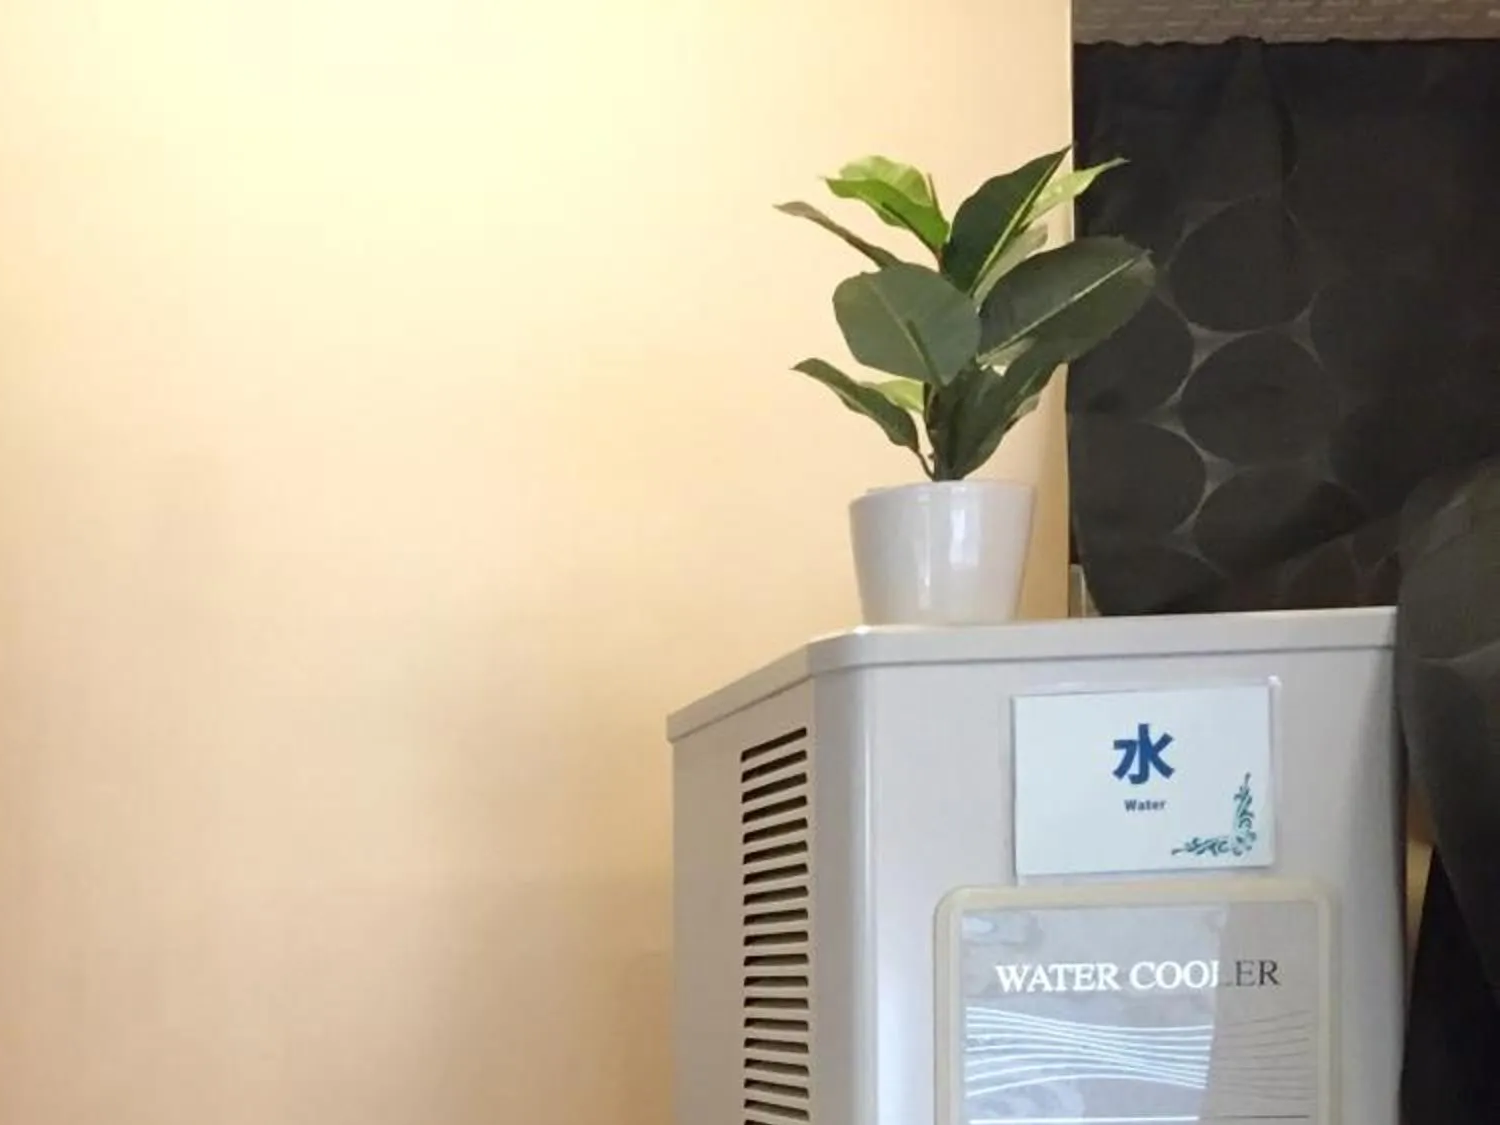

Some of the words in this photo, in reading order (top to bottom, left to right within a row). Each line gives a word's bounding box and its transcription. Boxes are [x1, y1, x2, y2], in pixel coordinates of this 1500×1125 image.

[1112, 723, 1175, 785] 水
[1123, 799, 1167, 812] Water
[995, 961, 1124, 993] WATER
[1129, 958, 1281, 992] COOLER
